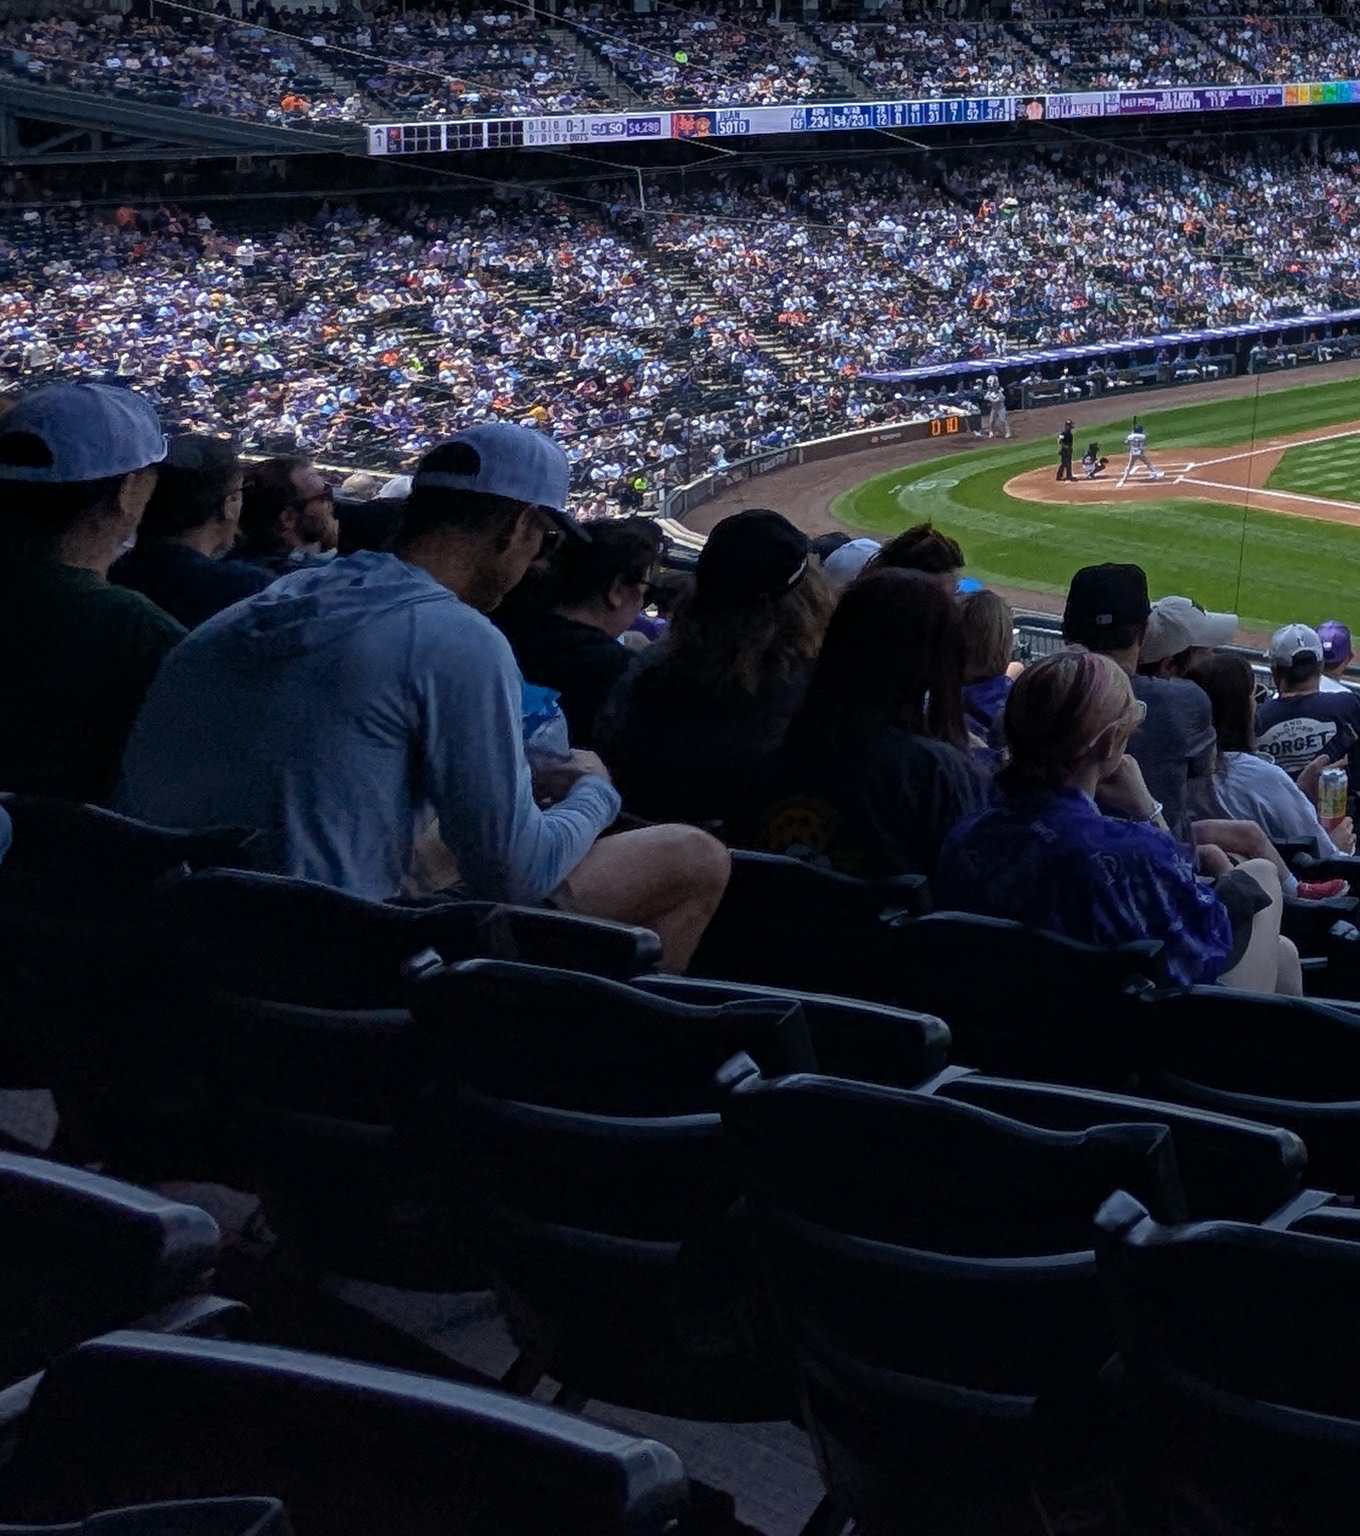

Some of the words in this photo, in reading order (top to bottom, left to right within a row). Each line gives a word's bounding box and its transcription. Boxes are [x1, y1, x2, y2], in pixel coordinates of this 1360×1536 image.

[808, 116, 829, 128] .234
[834, 114, 869, 127] 54/231
[877, 114, 886, 125] 12
[929, 111, 939, 122] 31
[719, 121, 746, 133] SOTO
[1272, 726, 1313, 740] ANOTHER
[1258, 732, 1327, 755] FORGET
